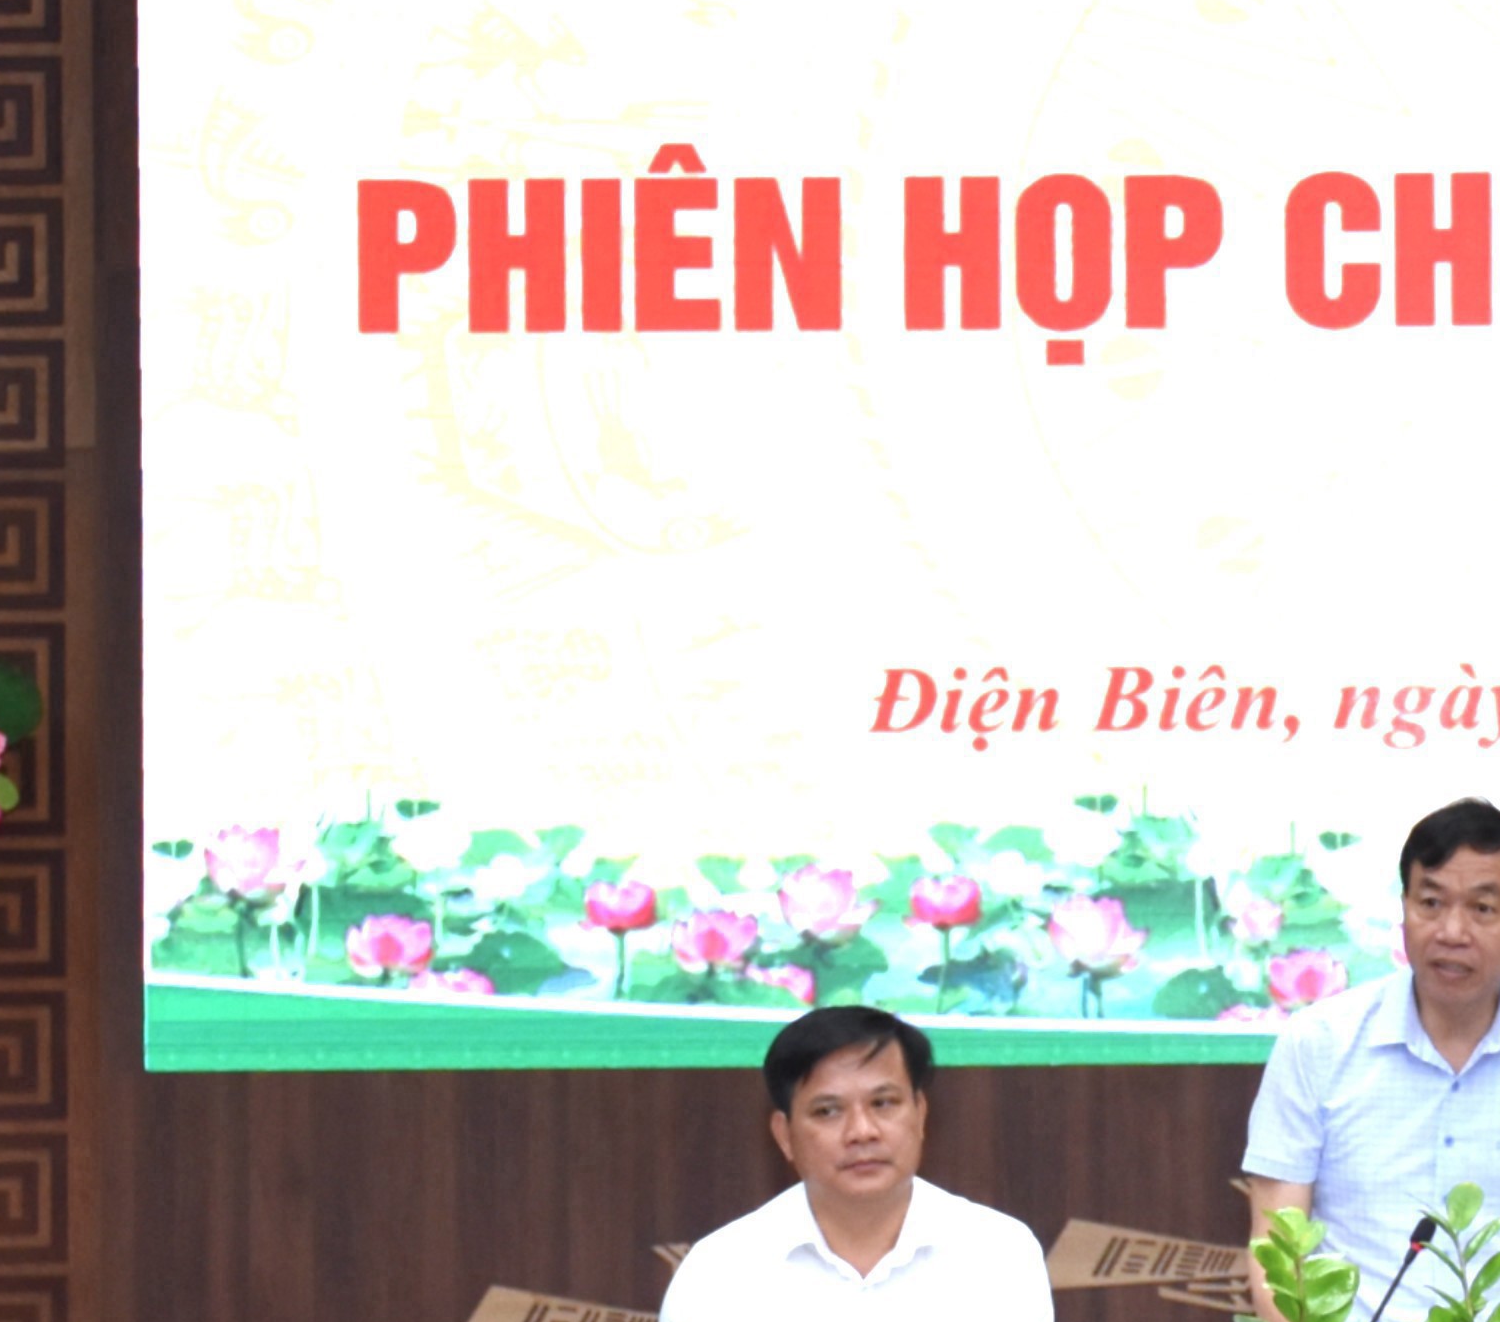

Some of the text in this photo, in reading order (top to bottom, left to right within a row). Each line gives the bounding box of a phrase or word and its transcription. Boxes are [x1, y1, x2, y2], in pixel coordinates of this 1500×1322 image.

[358, 143, 842, 334] PHIÊN
[904, 174, 1223, 366] HỌP
[871, 667, 1058, 751] Điện
[1096, 665, 1299, 738] Biên,
